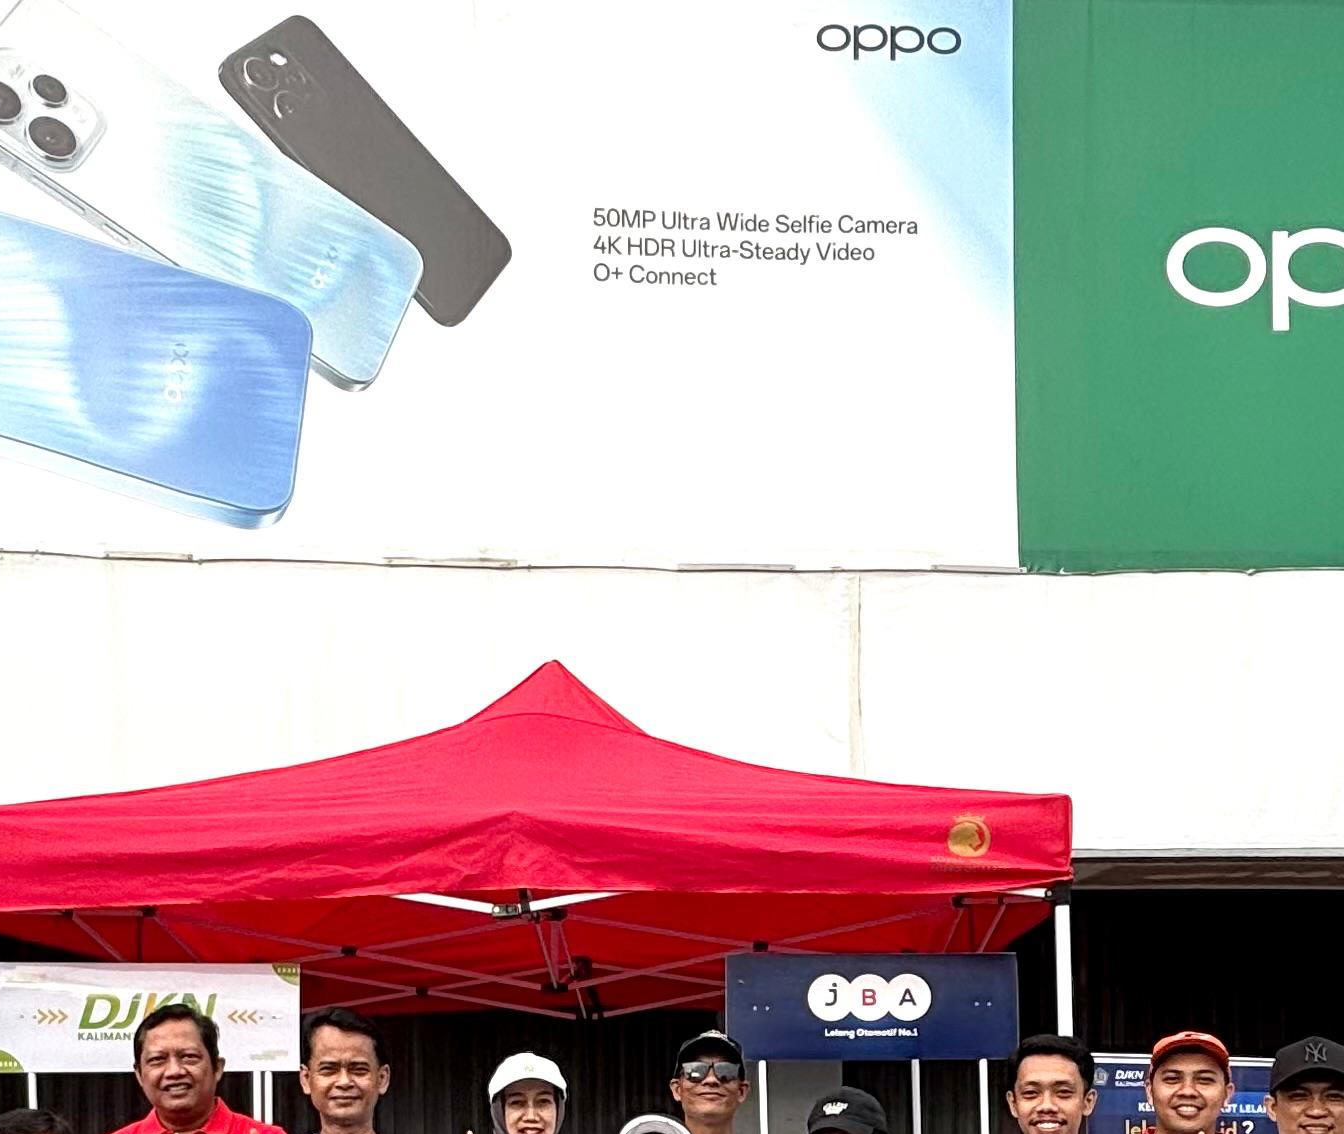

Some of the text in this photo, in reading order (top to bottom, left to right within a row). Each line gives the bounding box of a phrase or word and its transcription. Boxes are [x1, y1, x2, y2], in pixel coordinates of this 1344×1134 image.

[816, 24, 962, 61] oppo
[593, 208, 919, 235] 50MP Ultra Wide Selfie Camera
[593, 235, 875, 265] 4K HDR Ultra-Steady Video
[593, 263, 717, 286] O+ Connect
[77, 1032, 135, 1042] KALIMAN
[825, 1028, 856, 1039] Lelang
